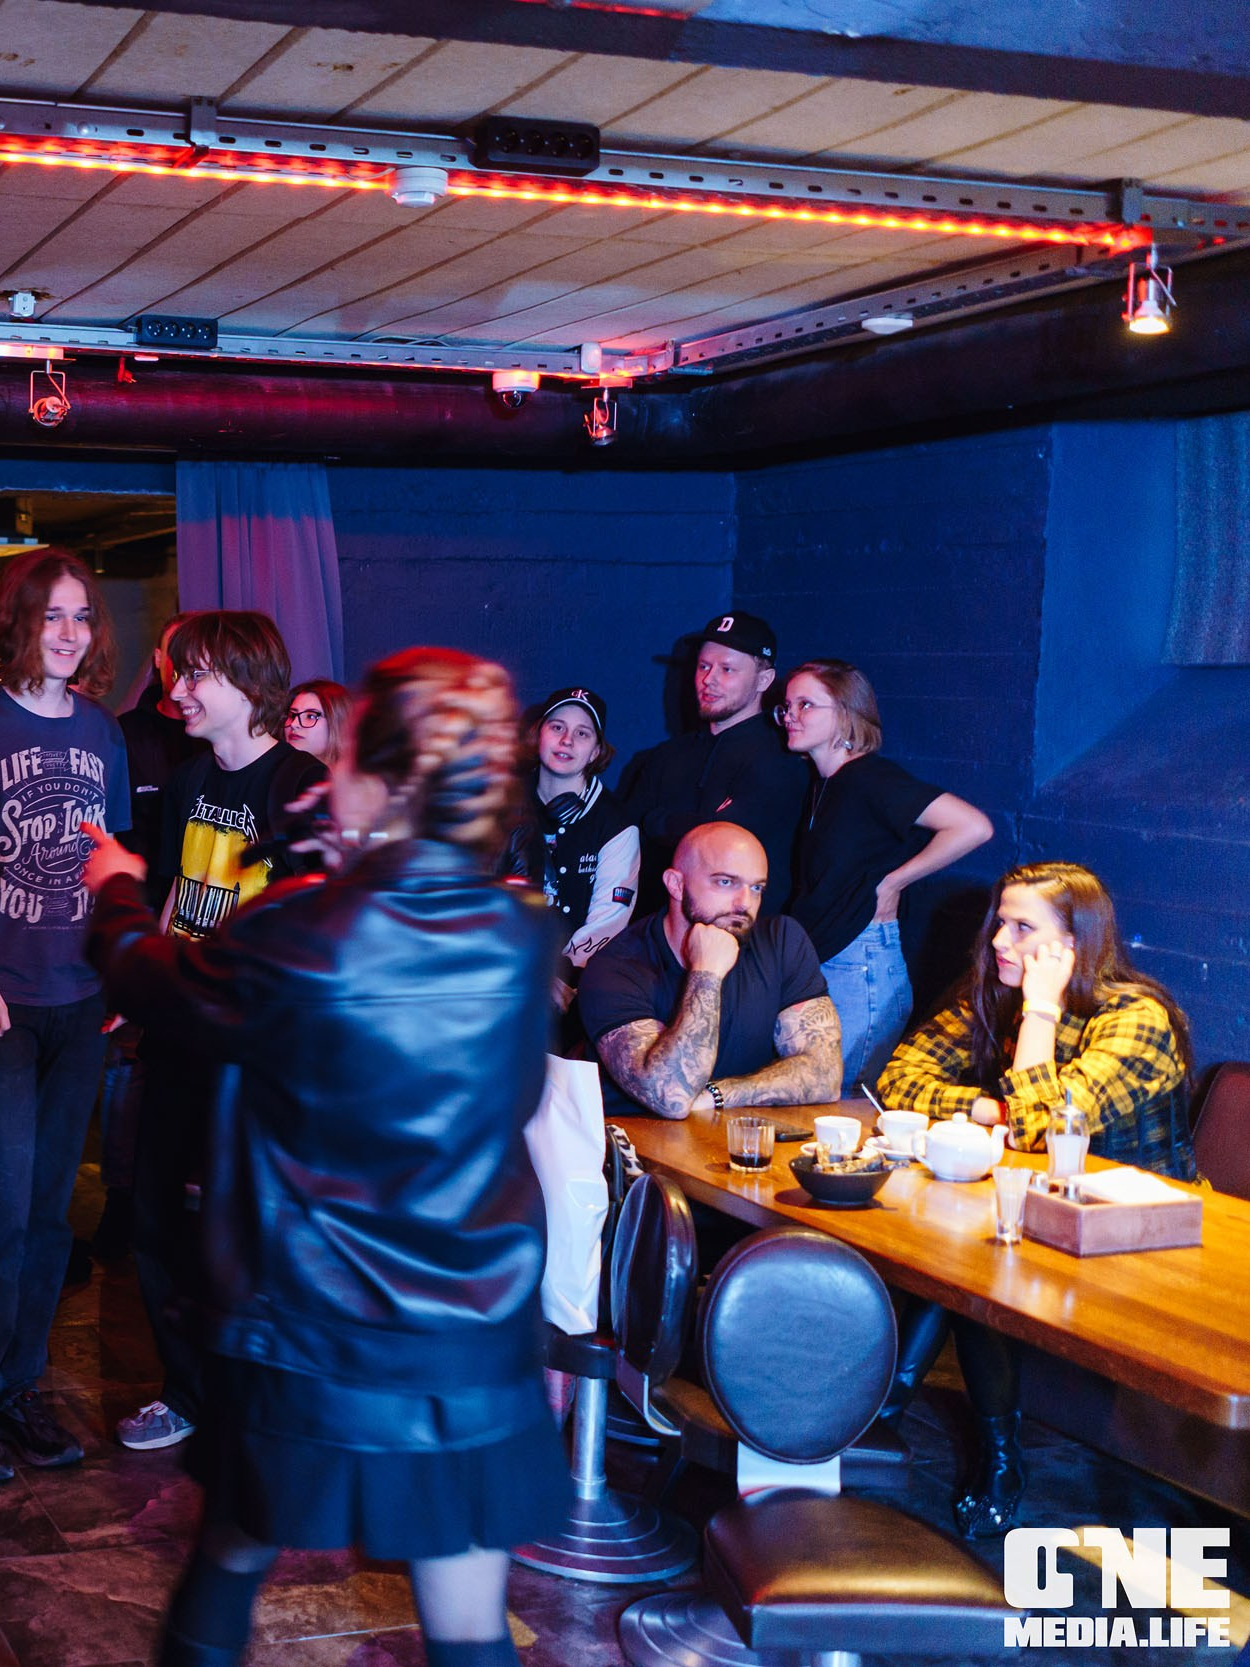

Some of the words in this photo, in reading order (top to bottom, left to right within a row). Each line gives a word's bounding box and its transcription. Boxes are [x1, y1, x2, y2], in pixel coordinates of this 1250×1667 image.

[717, 616, 734, 632] D
[0, 746, 43, 791] LIFE
[69, 747, 105, 790] FAST
[21, 790, 34, 802] IF
[37, 782, 60, 794] YOU
[64, 782, 99, 801] DON'T
[22, 841, 79, 865] Around
[13, 862, 44, 883] ONCE
[48, 877, 62, 885] IN
[65, 875, 73, 884] A
[0, 877, 45, 923] YOU
